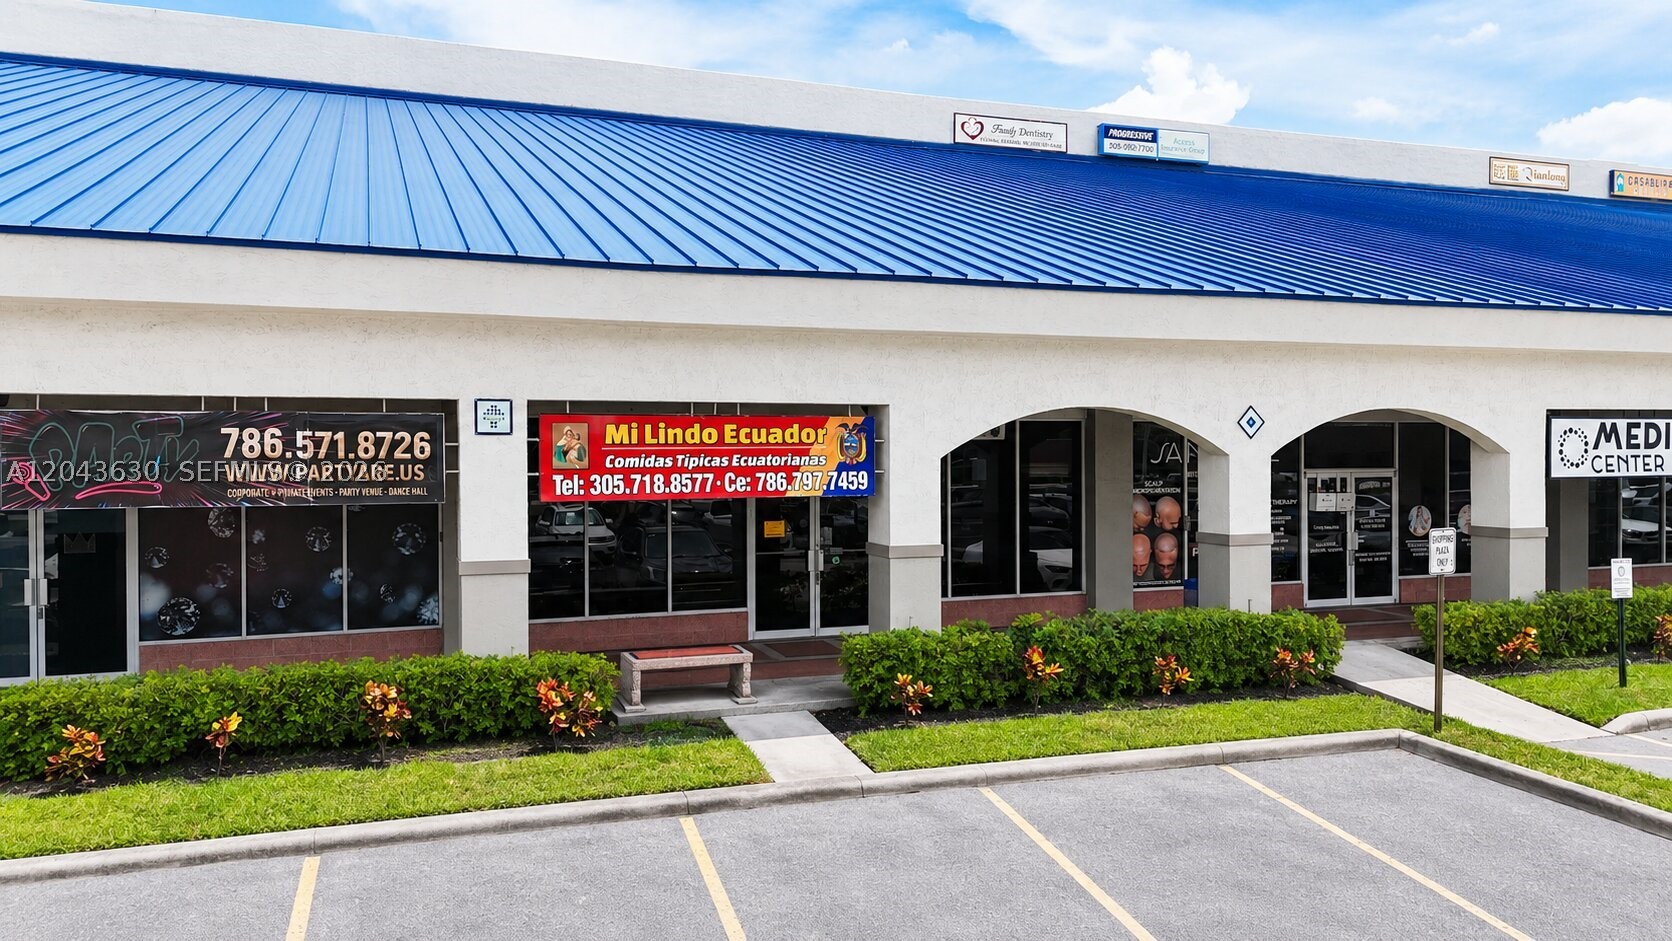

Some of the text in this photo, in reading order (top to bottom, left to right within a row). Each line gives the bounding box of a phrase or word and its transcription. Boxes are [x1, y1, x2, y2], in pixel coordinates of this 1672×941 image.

[1019, 127, 1054, 140] Dentistry
[1108, 128, 1154, 141] PROGRESSIVE
[605, 422, 828, 445] Mi Lindo Ecuador
[1592, 421, 1671, 450] MEDI
[220, 427, 431, 460] 786.571.8726
[605, 454, 673, 468] Comidas
[732, 453, 826, 467] Ecuatorianas
[1591, 454, 1665, 474] CENTER
[552, 470, 868, 496] Tel: 305.718.8577 Ce: 786.797.7459
[227, 488, 269, 498] CORPORATE
[308, 488, 334, 498] EVENTS
[339, 487, 361, 497] PARTY
[361, 487, 383, 497] VENUE
[388, 487, 410, 496] DANCE
[411, 487, 428, 496] HALL
[1432, 534, 1454, 545] SHOPPING
[1436, 546, 1450, 555] PLAZA
